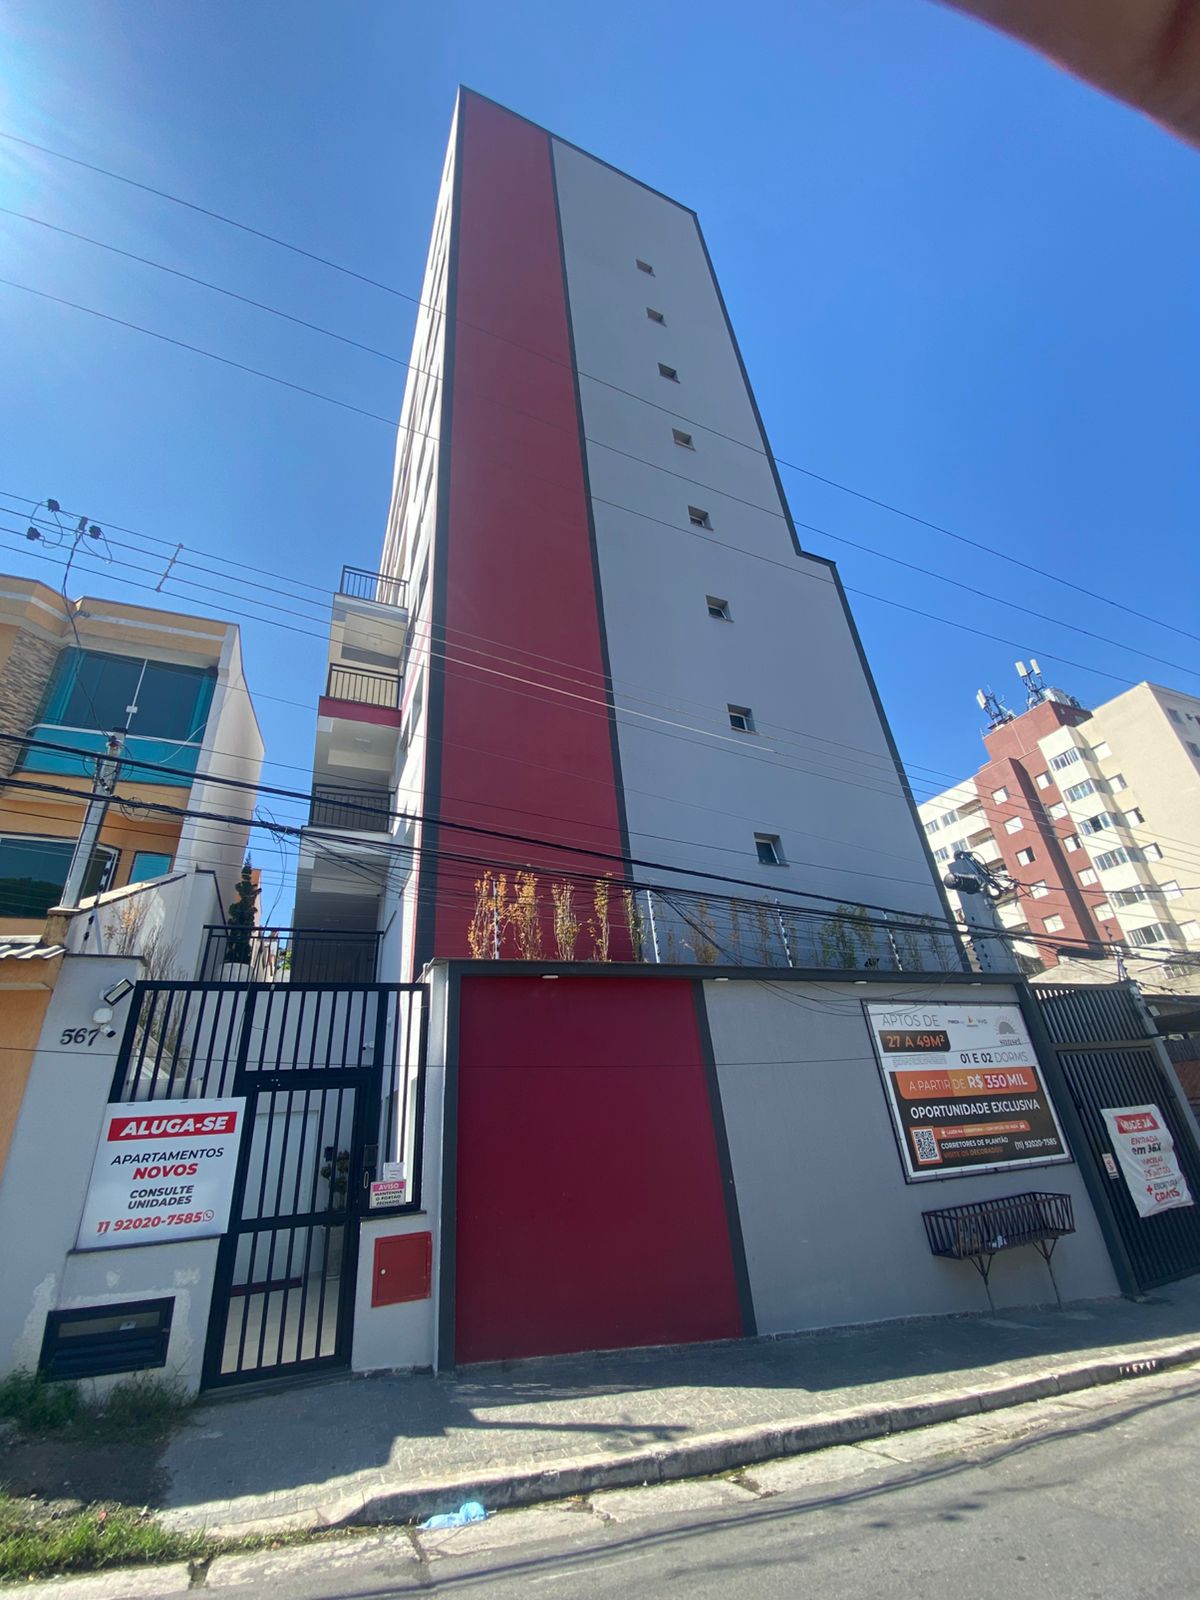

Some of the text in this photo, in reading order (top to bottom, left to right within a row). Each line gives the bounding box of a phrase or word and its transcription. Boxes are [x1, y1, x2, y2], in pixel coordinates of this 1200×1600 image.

[882, 1014, 941, 1027] APTOS DE
[60, 1028, 100, 1046] 567
[886, 1035, 900, 1048] 27
[905, 1035, 914, 1047] A
[960, 1053, 971, 1064] 01
[973, 1053, 979, 1063] E
[981, 1053, 993, 1063] 02
[994, 1051, 1029, 1063] DORMS
[909, 1073, 1028, 1091] A PARTIR DE R$ 350 MIL
[910, 1099, 1040, 1119] OPORTUNIDADE EXCLUSIVA
[119, 1116, 229, 1137] ALUGA-SE
[941, 1140, 977, 1149] CORRETORES
[111, 1147, 224, 1165] APARTAMENTOS
[132, 1163, 198, 1180] NOVOS
[130, 1185, 194, 1199] CONSULTE
[378, 1182, 399, 1190] AVISO
[128, 1195, 192, 1210] UNIDADES
[97, 1212, 203, 1233] 11 92020-7585
